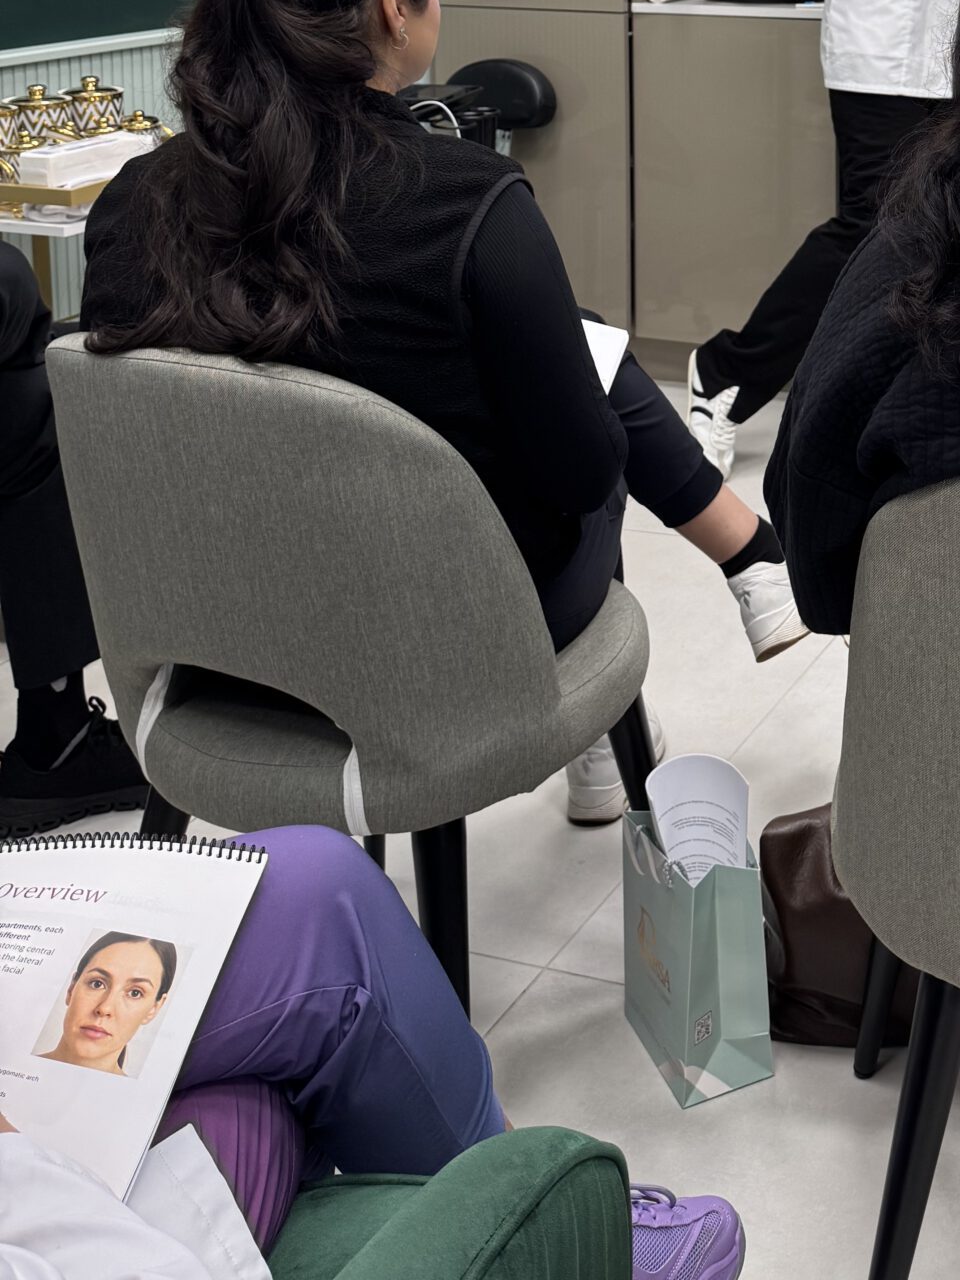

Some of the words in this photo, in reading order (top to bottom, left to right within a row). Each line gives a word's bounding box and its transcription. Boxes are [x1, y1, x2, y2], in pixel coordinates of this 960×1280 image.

[0, 882, 108, 904] Overview
[0, 922, 42, 933] partments,
[44, 925, 65, 935] each
[27, 945, 56, 957] central
[2, 952, 16, 962] the
[16, 954, 44, 967] lateral
[2, 964, 25, 976] facial
[26, 1074, 40, 1083] arch
